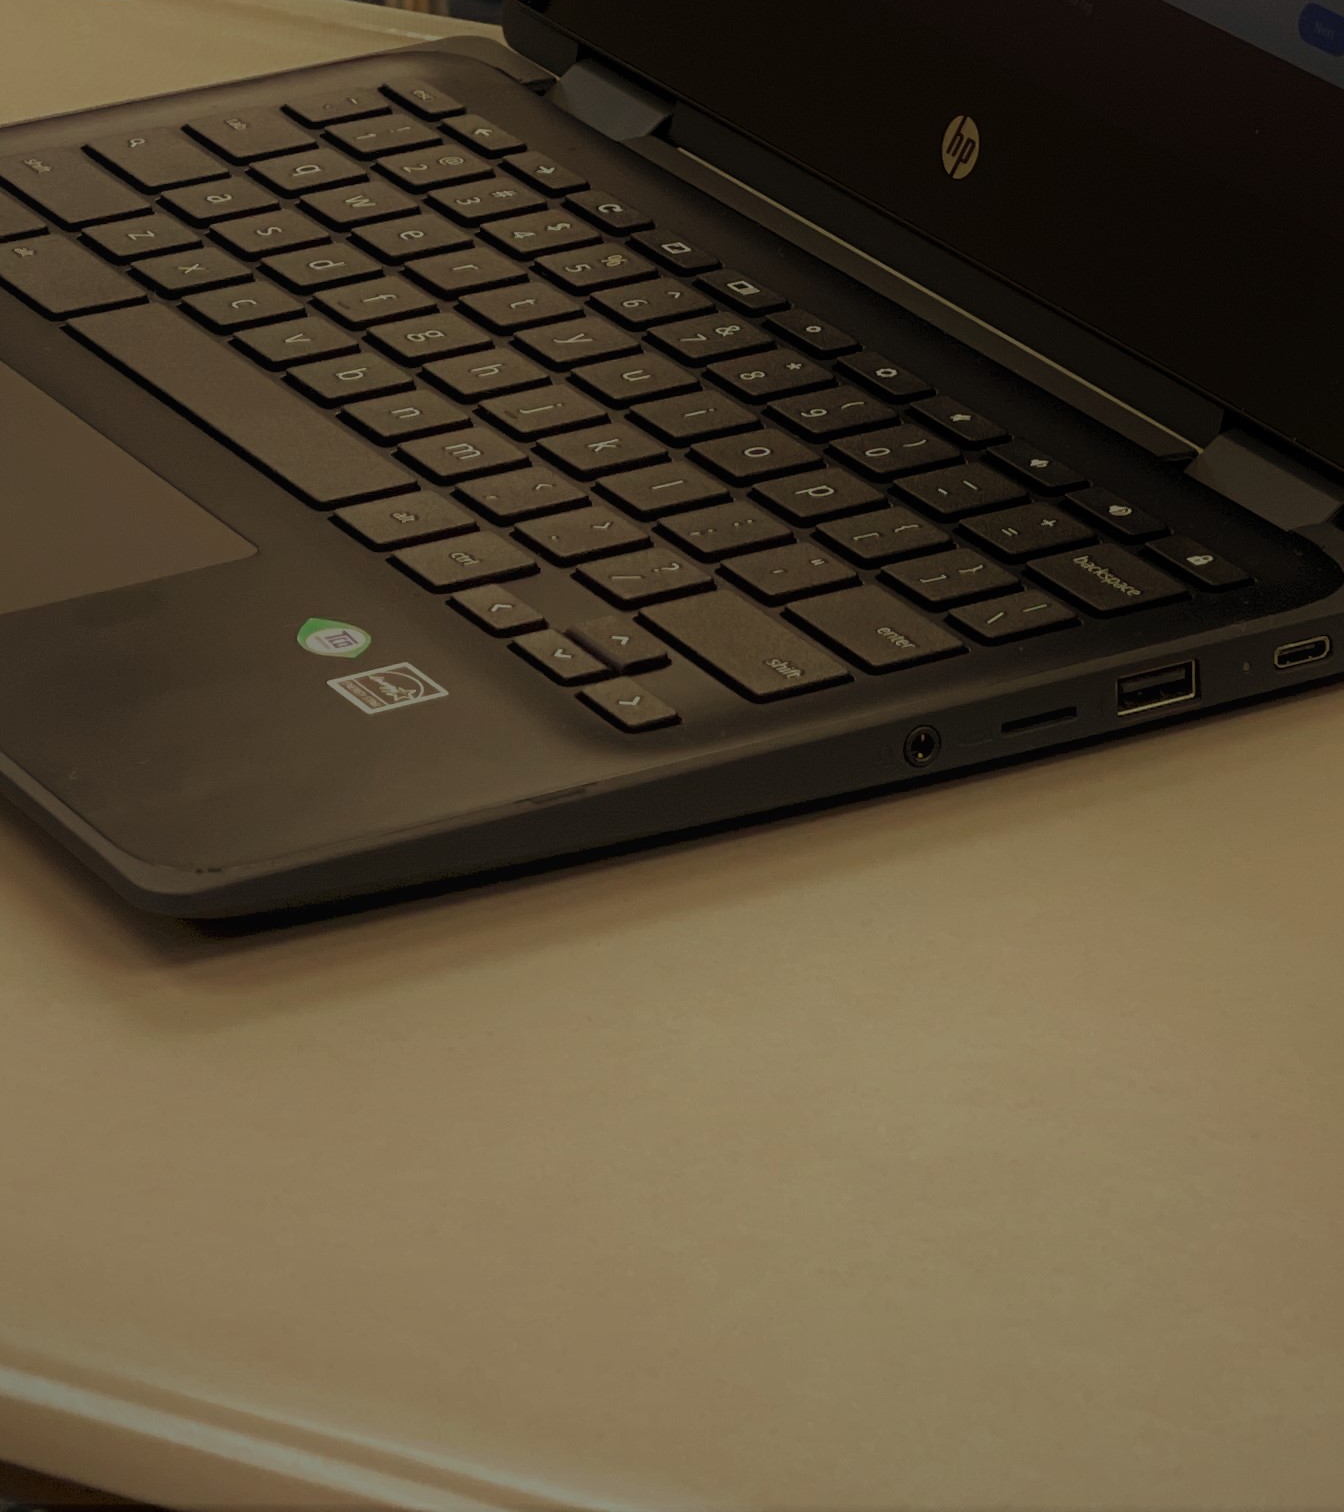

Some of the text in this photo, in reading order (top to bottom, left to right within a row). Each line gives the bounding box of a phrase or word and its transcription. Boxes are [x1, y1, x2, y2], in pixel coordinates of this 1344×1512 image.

[942, 115, 980, 180] hp
[291, 163, 322, 177] q
[206, 193, 233, 205] a
[345, 194, 377, 208] w
[127, 230, 156, 241] z
[256, 226, 283, 238] s
[399, 230, 425, 241] e
[178, 263, 206, 274] x
[308, 258, 346, 270] d
[563, 262, 593, 274] 5
[362, 293, 398, 303] f
[621, 298, 649, 309] 6
[231, 299, 258, 311] c
[284, 333, 312, 344] v
[405, 328, 446, 343] g
[552, 332, 594, 344] y
[335, 367, 368, 382] b
[470, 363, 503, 378] h
[622, 369, 652, 382] u
[739, 370, 766, 381] 8
[391, 406, 421, 419] n
[519, 402, 563, 415] j
[800, 408, 828, 420] 9
[444, 442, 481, 461] m
[743, 446, 772, 458] o
[794, 484, 835, 498] p
[1072, 555, 1141, 598] backspace
[875, 626, 919, 651] enter
[765, 657, 805, 680] shift
